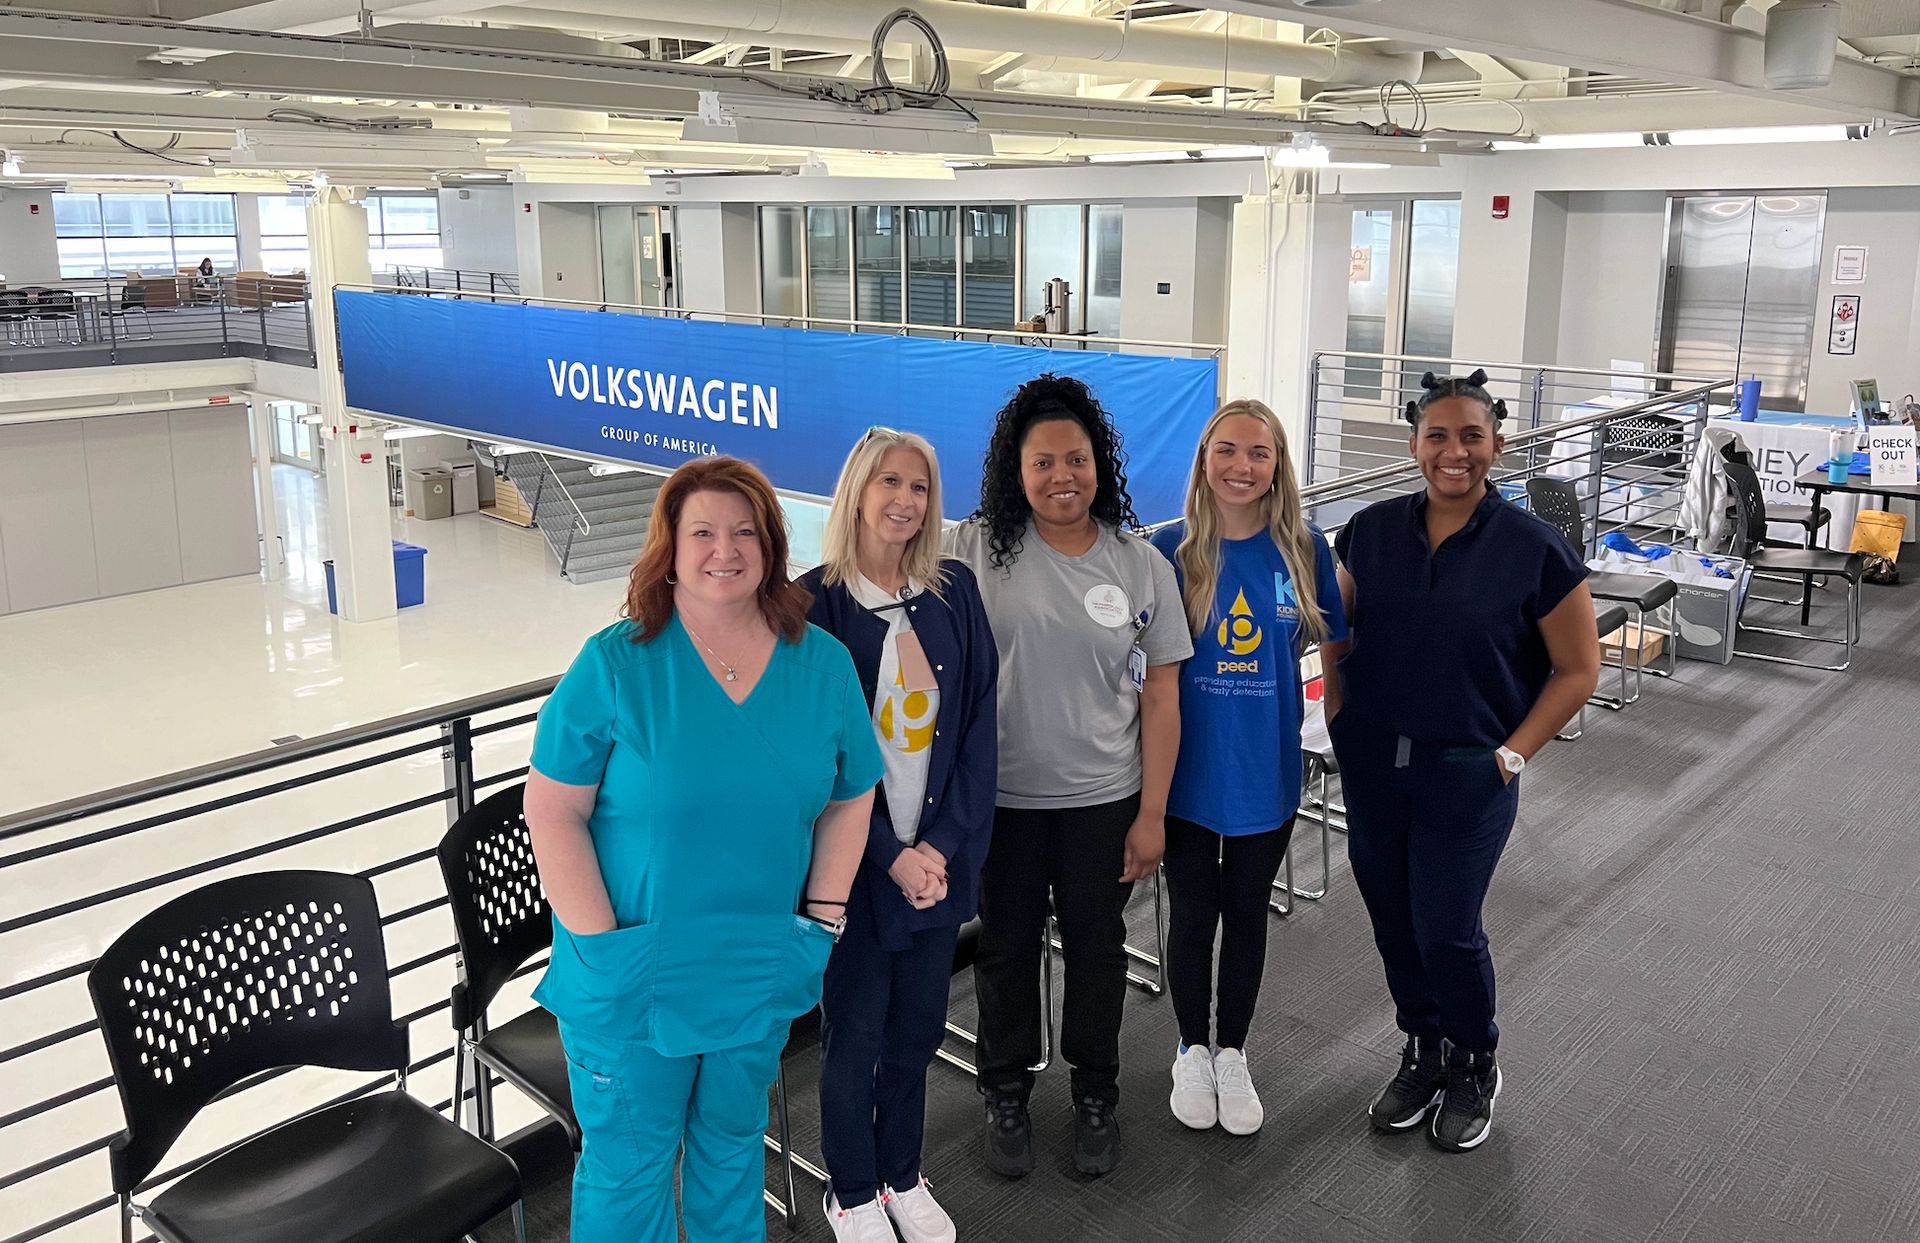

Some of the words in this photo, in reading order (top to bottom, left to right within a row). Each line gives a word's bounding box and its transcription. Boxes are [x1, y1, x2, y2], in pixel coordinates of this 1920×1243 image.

[547, 358, 778, 429] VOLKSWAGEN
[601, 425, 640, 443] GROUP
[644, 432, 658, 447] OF
[662, 436, 718, 457] AMERICA
[1872, 438, 1913, 448] CHECK
[1881, 450, 1905, 460] OUT
[1752, 448, 1810, 477] NEY
[1679, 588, 1724, 599] chorder
[1217, 660, 1259, 674] peed
[1194, 676, 1235, 688] providing
[1236, 679, 1277, 688] educatio
[1200, 683, 1208, 692] &
[1208, 686, 1231, 697] early
[1232, 687, 1275, 697] detection
